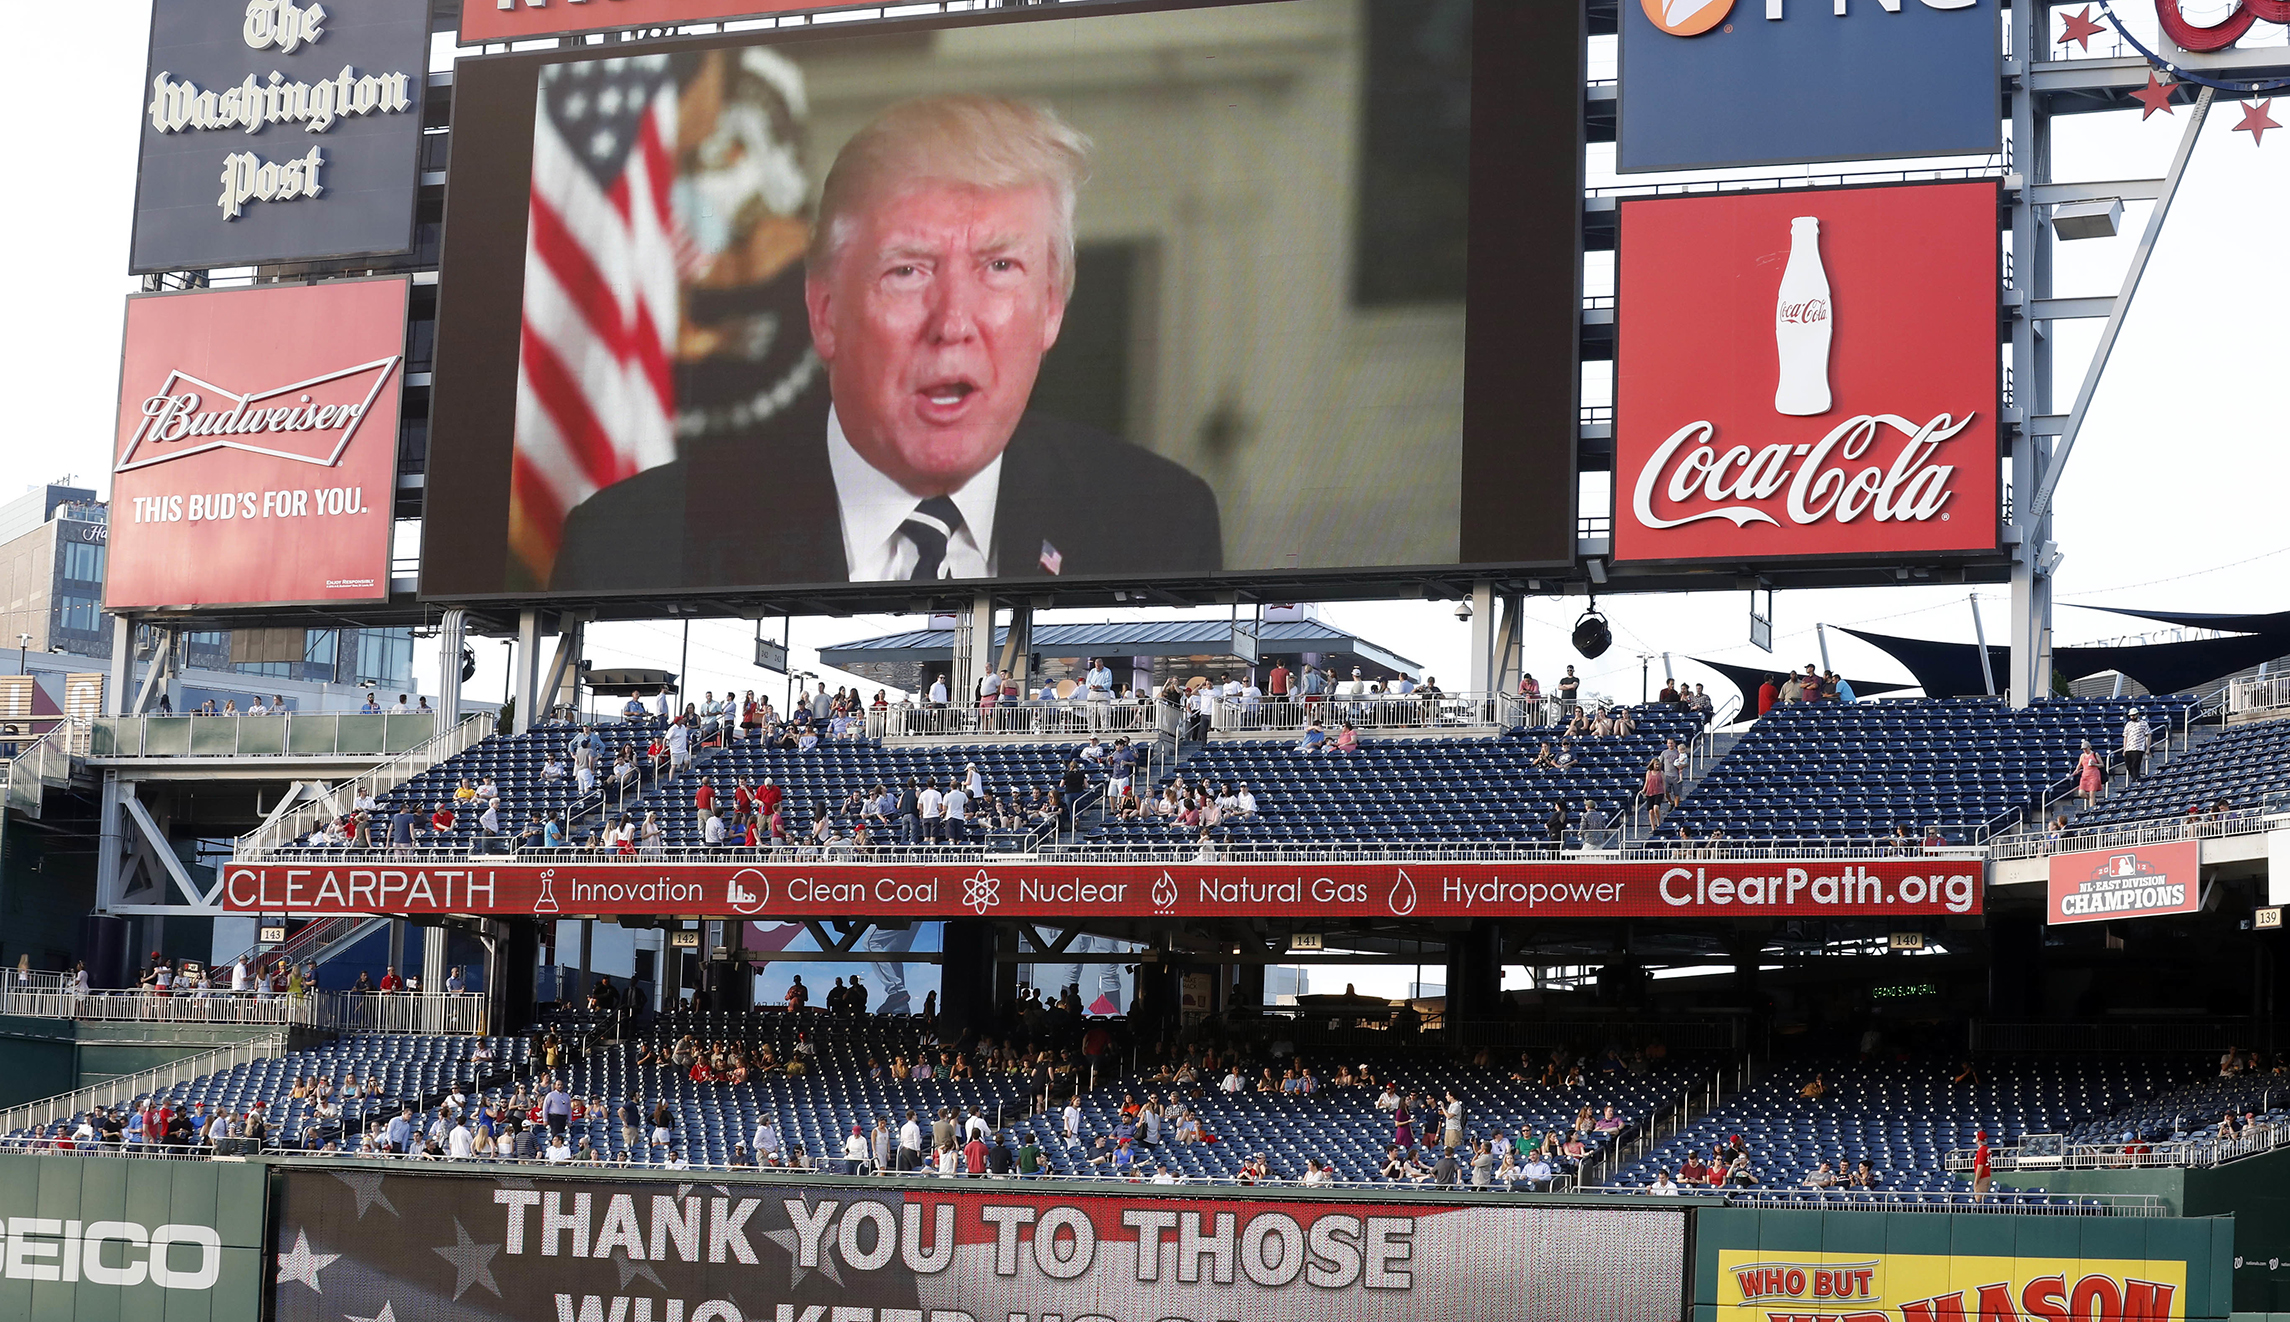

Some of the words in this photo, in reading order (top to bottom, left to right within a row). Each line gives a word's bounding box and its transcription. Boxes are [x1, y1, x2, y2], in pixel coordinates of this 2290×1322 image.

[243, 0, 329, 54] The
[149, 64, 412, 134] Washington
[218, 145, 325, 221] Post
[1779, 298, 1827, 324] Coca-Cola
[142, 393, 361, 443] Budweiser
[1632, 410, 1975, 529] Coca-Cola
[133, 496, 182, 524] THIS
[188, 491, 257, 521] BUD'S
[263, 489, 307, 518] FOR
[314, 486, 368, 516] YOU.
[227, 868, 496, 908] CLEARPATH
[571, 876, 703, 902] Innovation
[787, 877, 866, 903] Clean
[874, 877, 938, 903] Coal
[1019, 878, 1127, 903] Nuclear
[1199, 877, 1304, 903] Natural
[1311, 878, 1367, 903] Gas
[1443, 876, 1625, 909] Hydropower
[1658, 866, 1974, 913] ClearPath.org
[2122, 874, 2166, 889] DIVISION
[2061, 884, 2185, 915] CHAMPIONS
[2260, 911, 2277, 923] 139
[265, 930, 280, 939] 143
[676, 934, 694, 943] 142
[1297, 936, 1316, 946] 141
[1896, 935, 1917, 945] 140
[0, 1218, 221, 1289] EICO
[493, 1188, 762, 1265] THANK
[783, 1198, 955, 1274] YOU
[982, 1204, 1096, 1280] TO
[1122, 1209, 1415, 1289] THOSE
[1737, 1266, 1806, 1299] WHO
[1812, 1268, 1875, 1297] BUT
